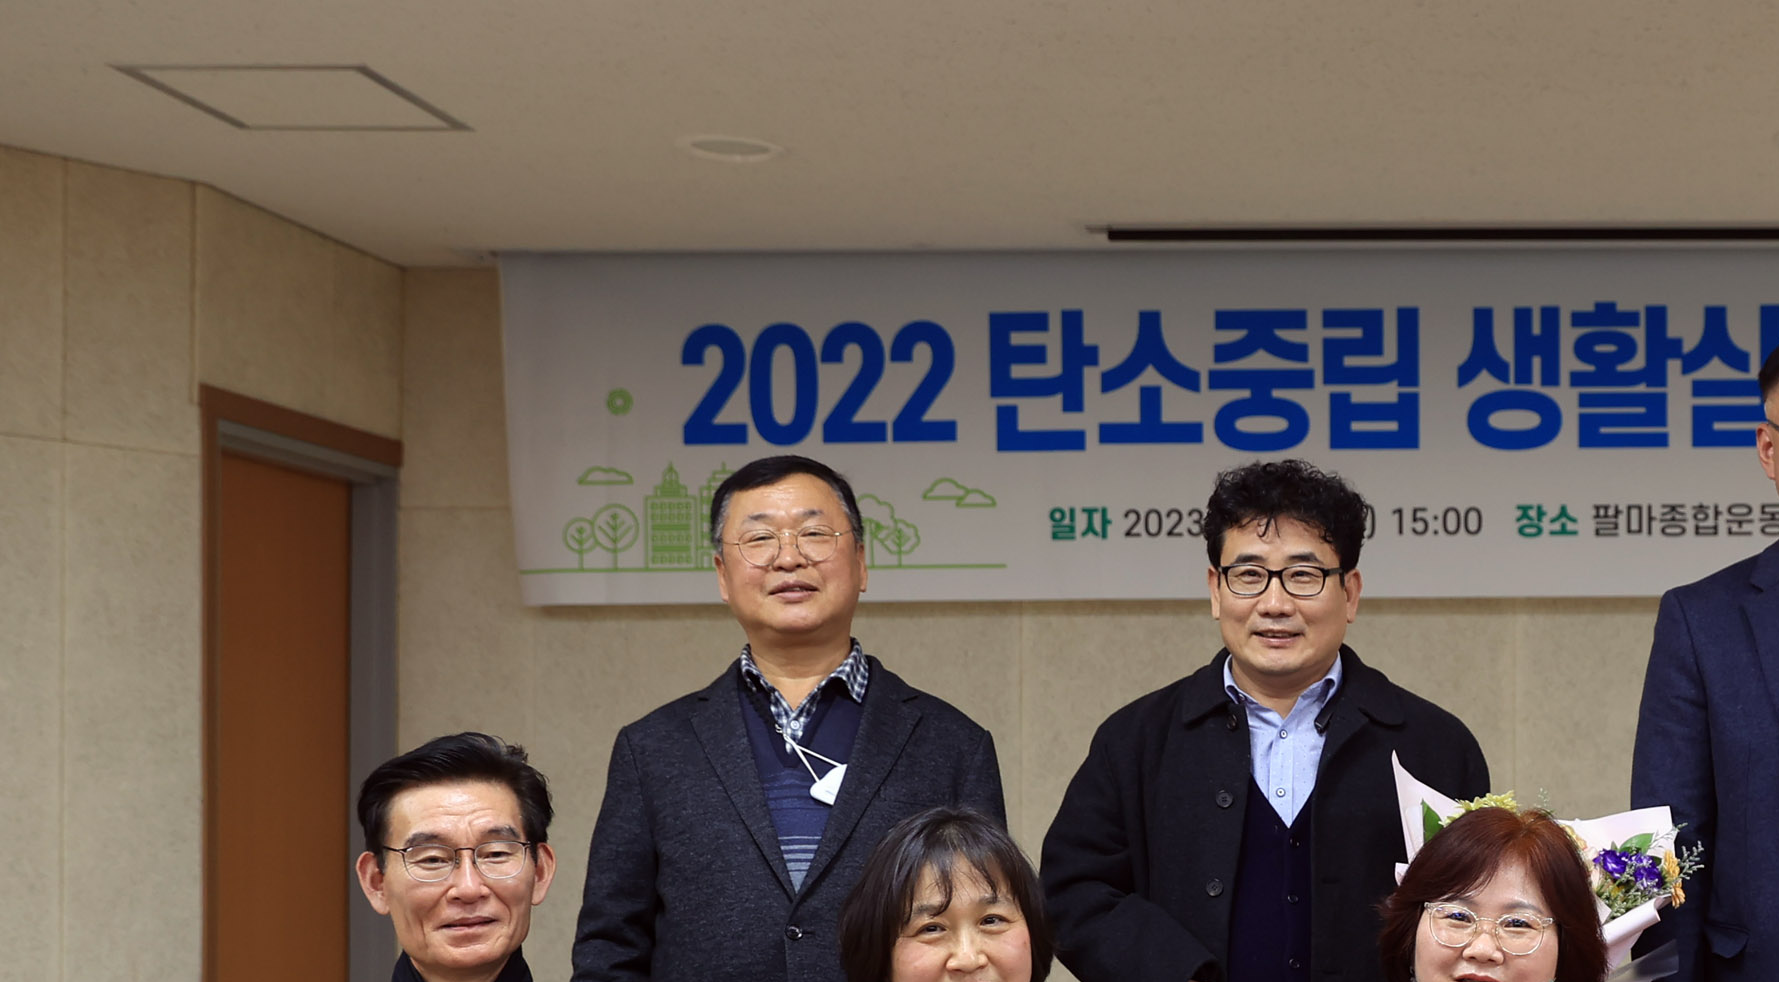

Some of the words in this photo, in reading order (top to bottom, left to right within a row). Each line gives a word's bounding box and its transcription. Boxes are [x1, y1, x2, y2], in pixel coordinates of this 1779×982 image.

[682, 322, 957, 446] 2022
[990, 307, 1420, 453] 탄소중립
[1046, 503, 1114, 543] 일자
[1124, 508, 1204, 537] 2023
[1392, 506, 1482, 536] 15:00
[1515, 503, 1578, 538] 장소
